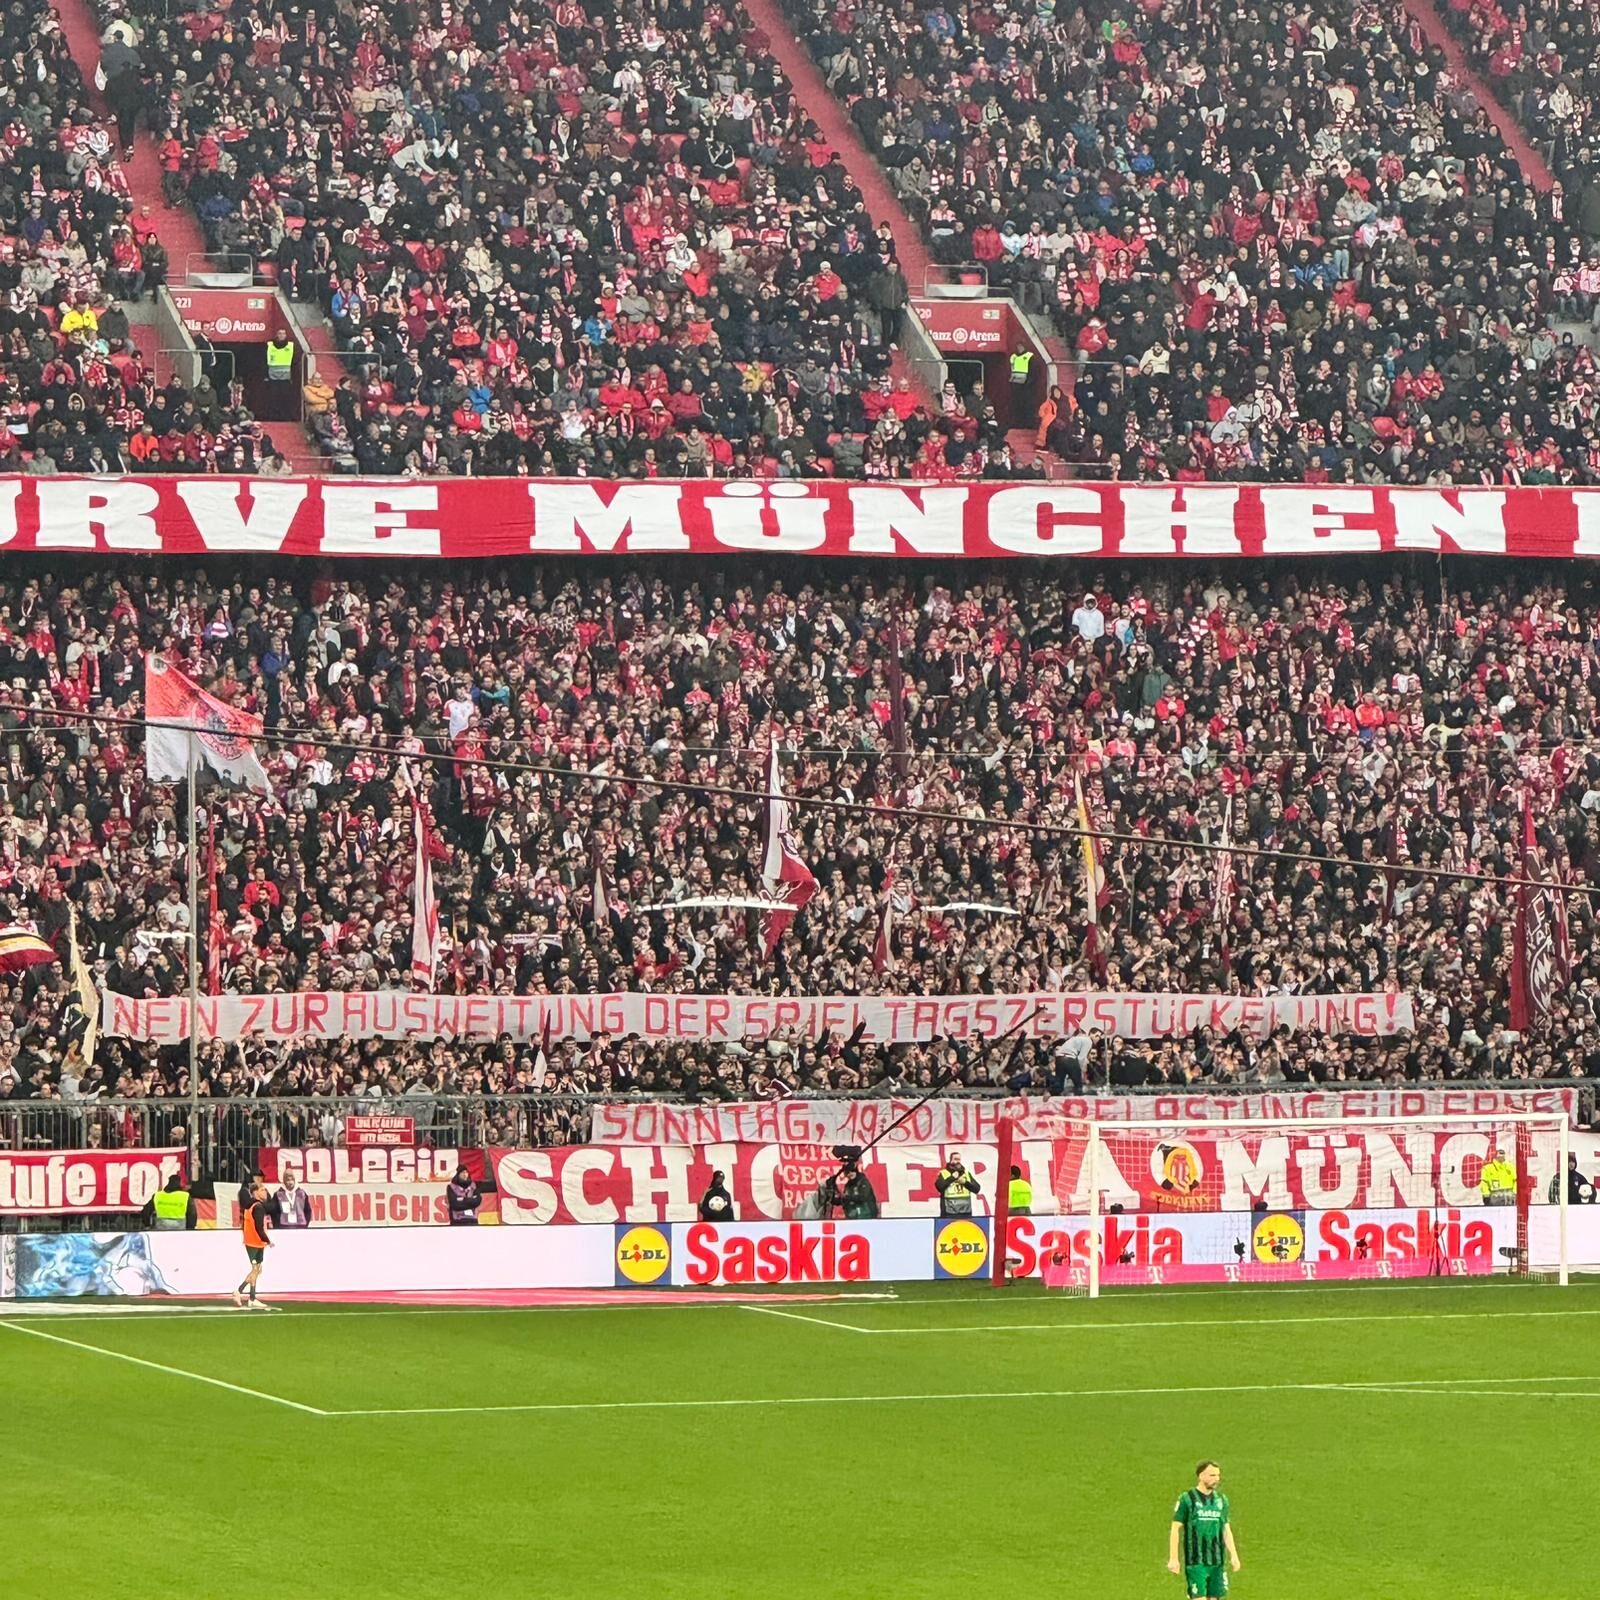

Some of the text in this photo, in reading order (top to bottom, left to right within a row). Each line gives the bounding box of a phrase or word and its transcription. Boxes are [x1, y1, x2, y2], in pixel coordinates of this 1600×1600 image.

[175, 297, 192, 308] 221
[232, 319, 266, 332] Arena
[969, 330, 1001, 342] Arena
[0, 482, 442, 555] RVE
[528, 482, 1507, 555] MÜNCHEN
[113, 996, 217, 1037] NEIN
[241, 991, 328, 1035] ZUR
[343, 993, 624, 1037] AUSWEITUNG
[645, 997, 730, 1037] DER
[602, 1101, 825, 1142] SONNTAG,
[836, 1100, 933, 1143] 19:30
[105, 1156, 181, 1207] rot
[498, 1139, 1141, 1225] SCHICERIA
[686, 1222, 870, 1285] Saskia
[1007, 1215, 1182, 1279] Saskia
[1319, 1208, 1493, 1263] Saskia
